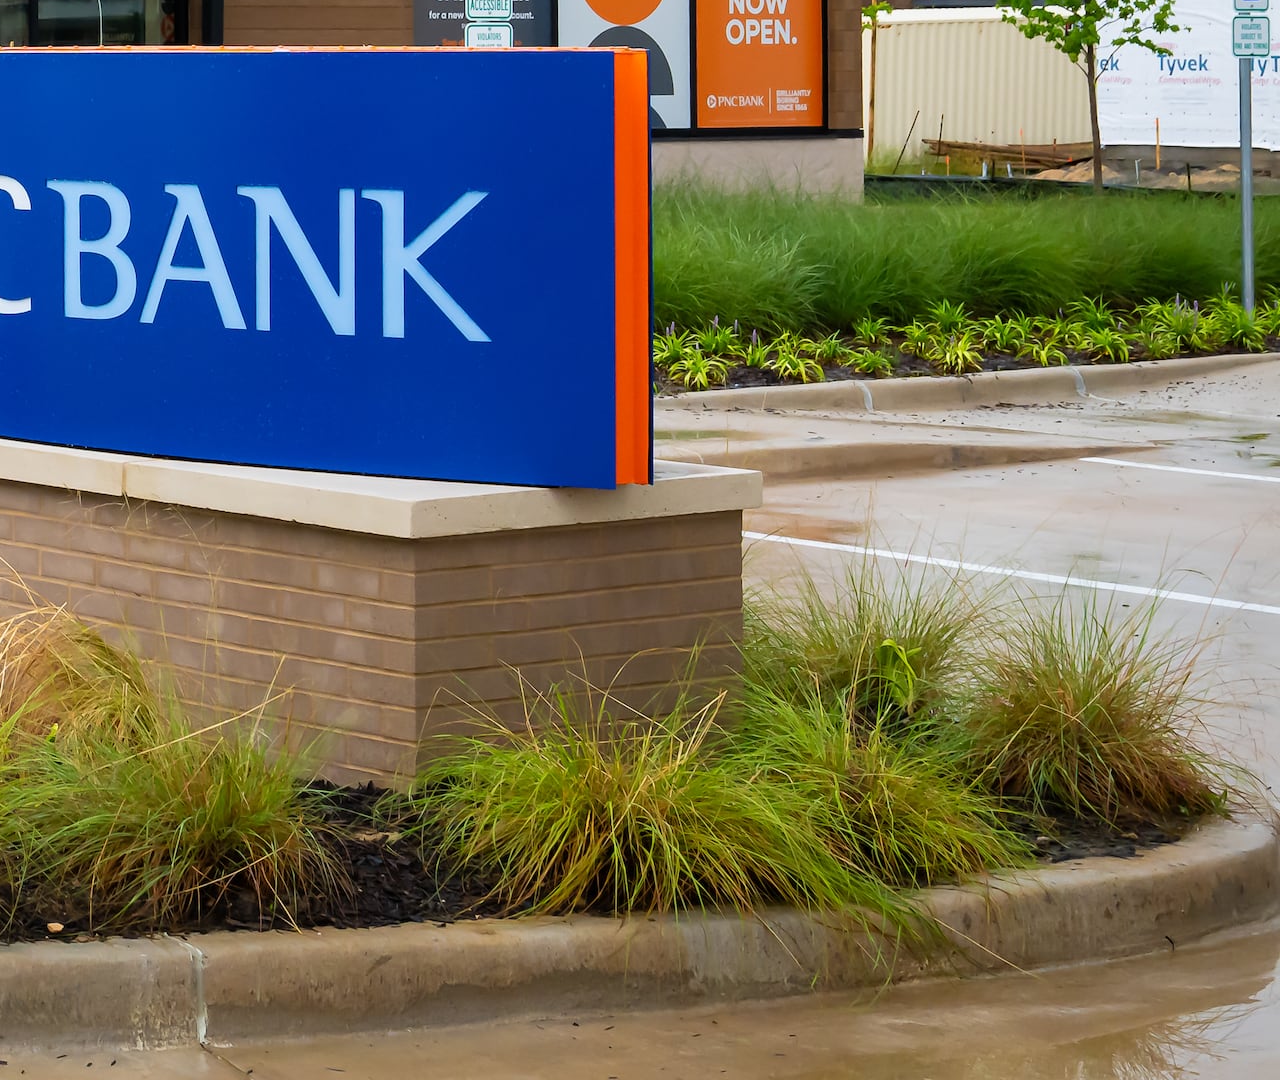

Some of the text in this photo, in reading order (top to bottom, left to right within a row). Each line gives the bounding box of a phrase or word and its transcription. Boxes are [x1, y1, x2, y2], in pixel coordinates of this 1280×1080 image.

[429, 10, 440, 19] for
[448, 11, 464, 19] new
[511, 11, 535, 19] count.
[477, 32, 502, 41] VIOLATORS
[725, 18, 798, 45] OPEN.
[1157, 53, 1208, 76] Tyvek
[718, 95, 764, 107] PNC BANK
[47, 179, 492, 344] BANK
